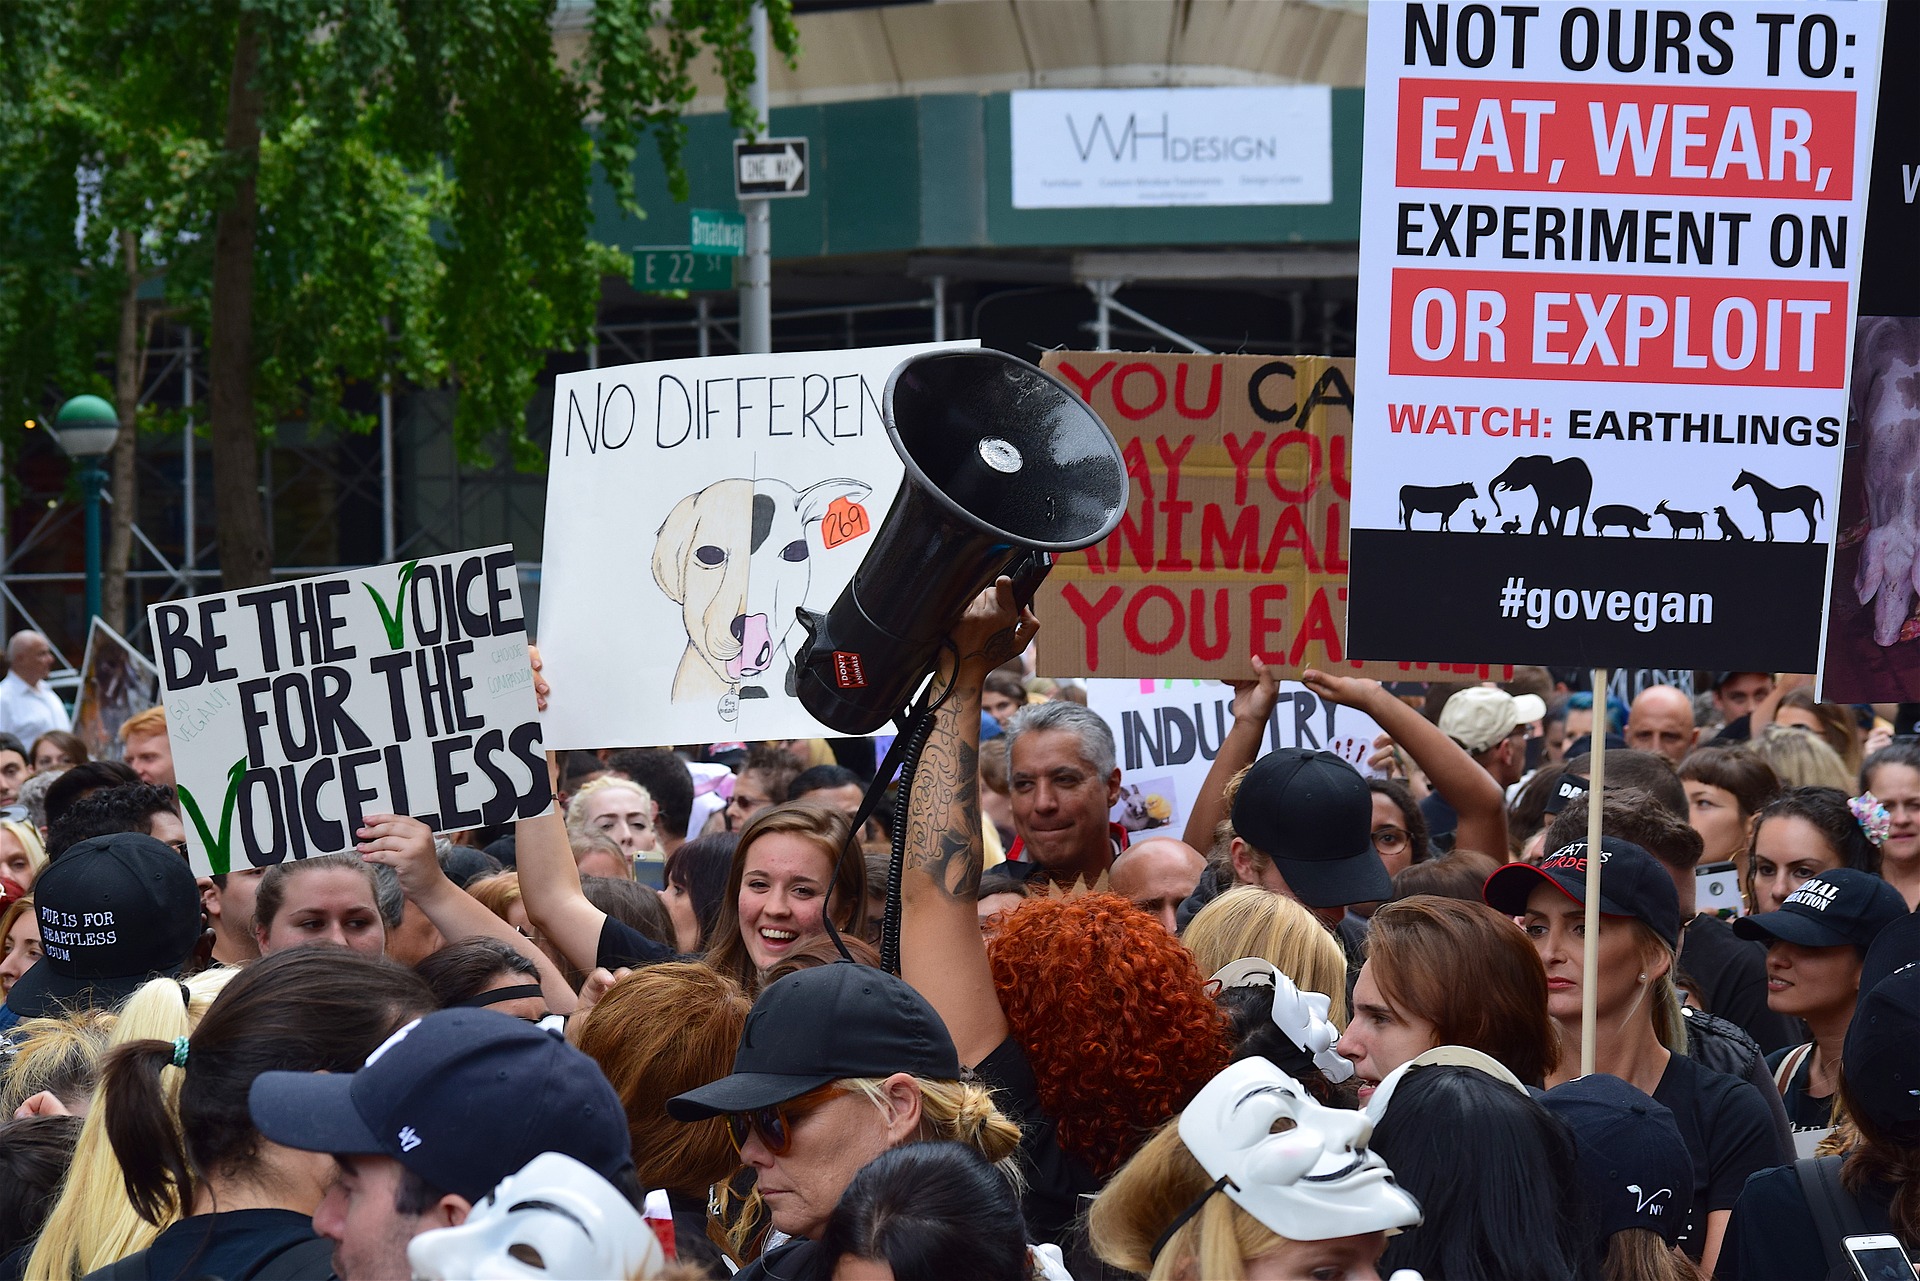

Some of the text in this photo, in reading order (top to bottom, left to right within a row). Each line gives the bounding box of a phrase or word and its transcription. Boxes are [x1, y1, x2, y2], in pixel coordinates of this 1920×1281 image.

[1403, 2, 1857, 80] NOT OURS TO:
[746, 158, 796, 180] ONE WAY
[1420, 96, 1567, 185] EAT,
[1587, 101, 1833, 193] WEAR,
[691, 215, 745, 256] Broadway
[1397, 203, 1849, 269] EXPERIMENT ON
[645, 254, 656, 284] E
[668, 253, 695, 284] 22
[1411, 287, 1832, 373] OR EXPLOIT
[565, 382, 636, 457] NO
[1056, 360, 1224, 422] YOU
[1387, 403, 1841, 448] WATCH: EARTHLINGS
[825, 505, 864, 546] 269
[1051, 500, 1350, 575] NIMAL
[154, 550, 527, 692] BE THE VOICE
[1060, 581, 1363, 673] YOU EA
[1499, 576, 1715, 633] #govegan
[837, 653, 849, 682] DON'T
[850, 655, 865, 685] ANIMALS
[169, 698, 190, 721] GO
[173, 687, 231, 742] VEGAN!
[237, 639, 486, 768] FOR THE
[1120, 690, 1339, 771] INDUTRY
[176, 721, 554, 875] VOICELESS
[41, 906, 115, 928] FUR IS FOR
[42, 925, 118, 946] HEARTLESS
